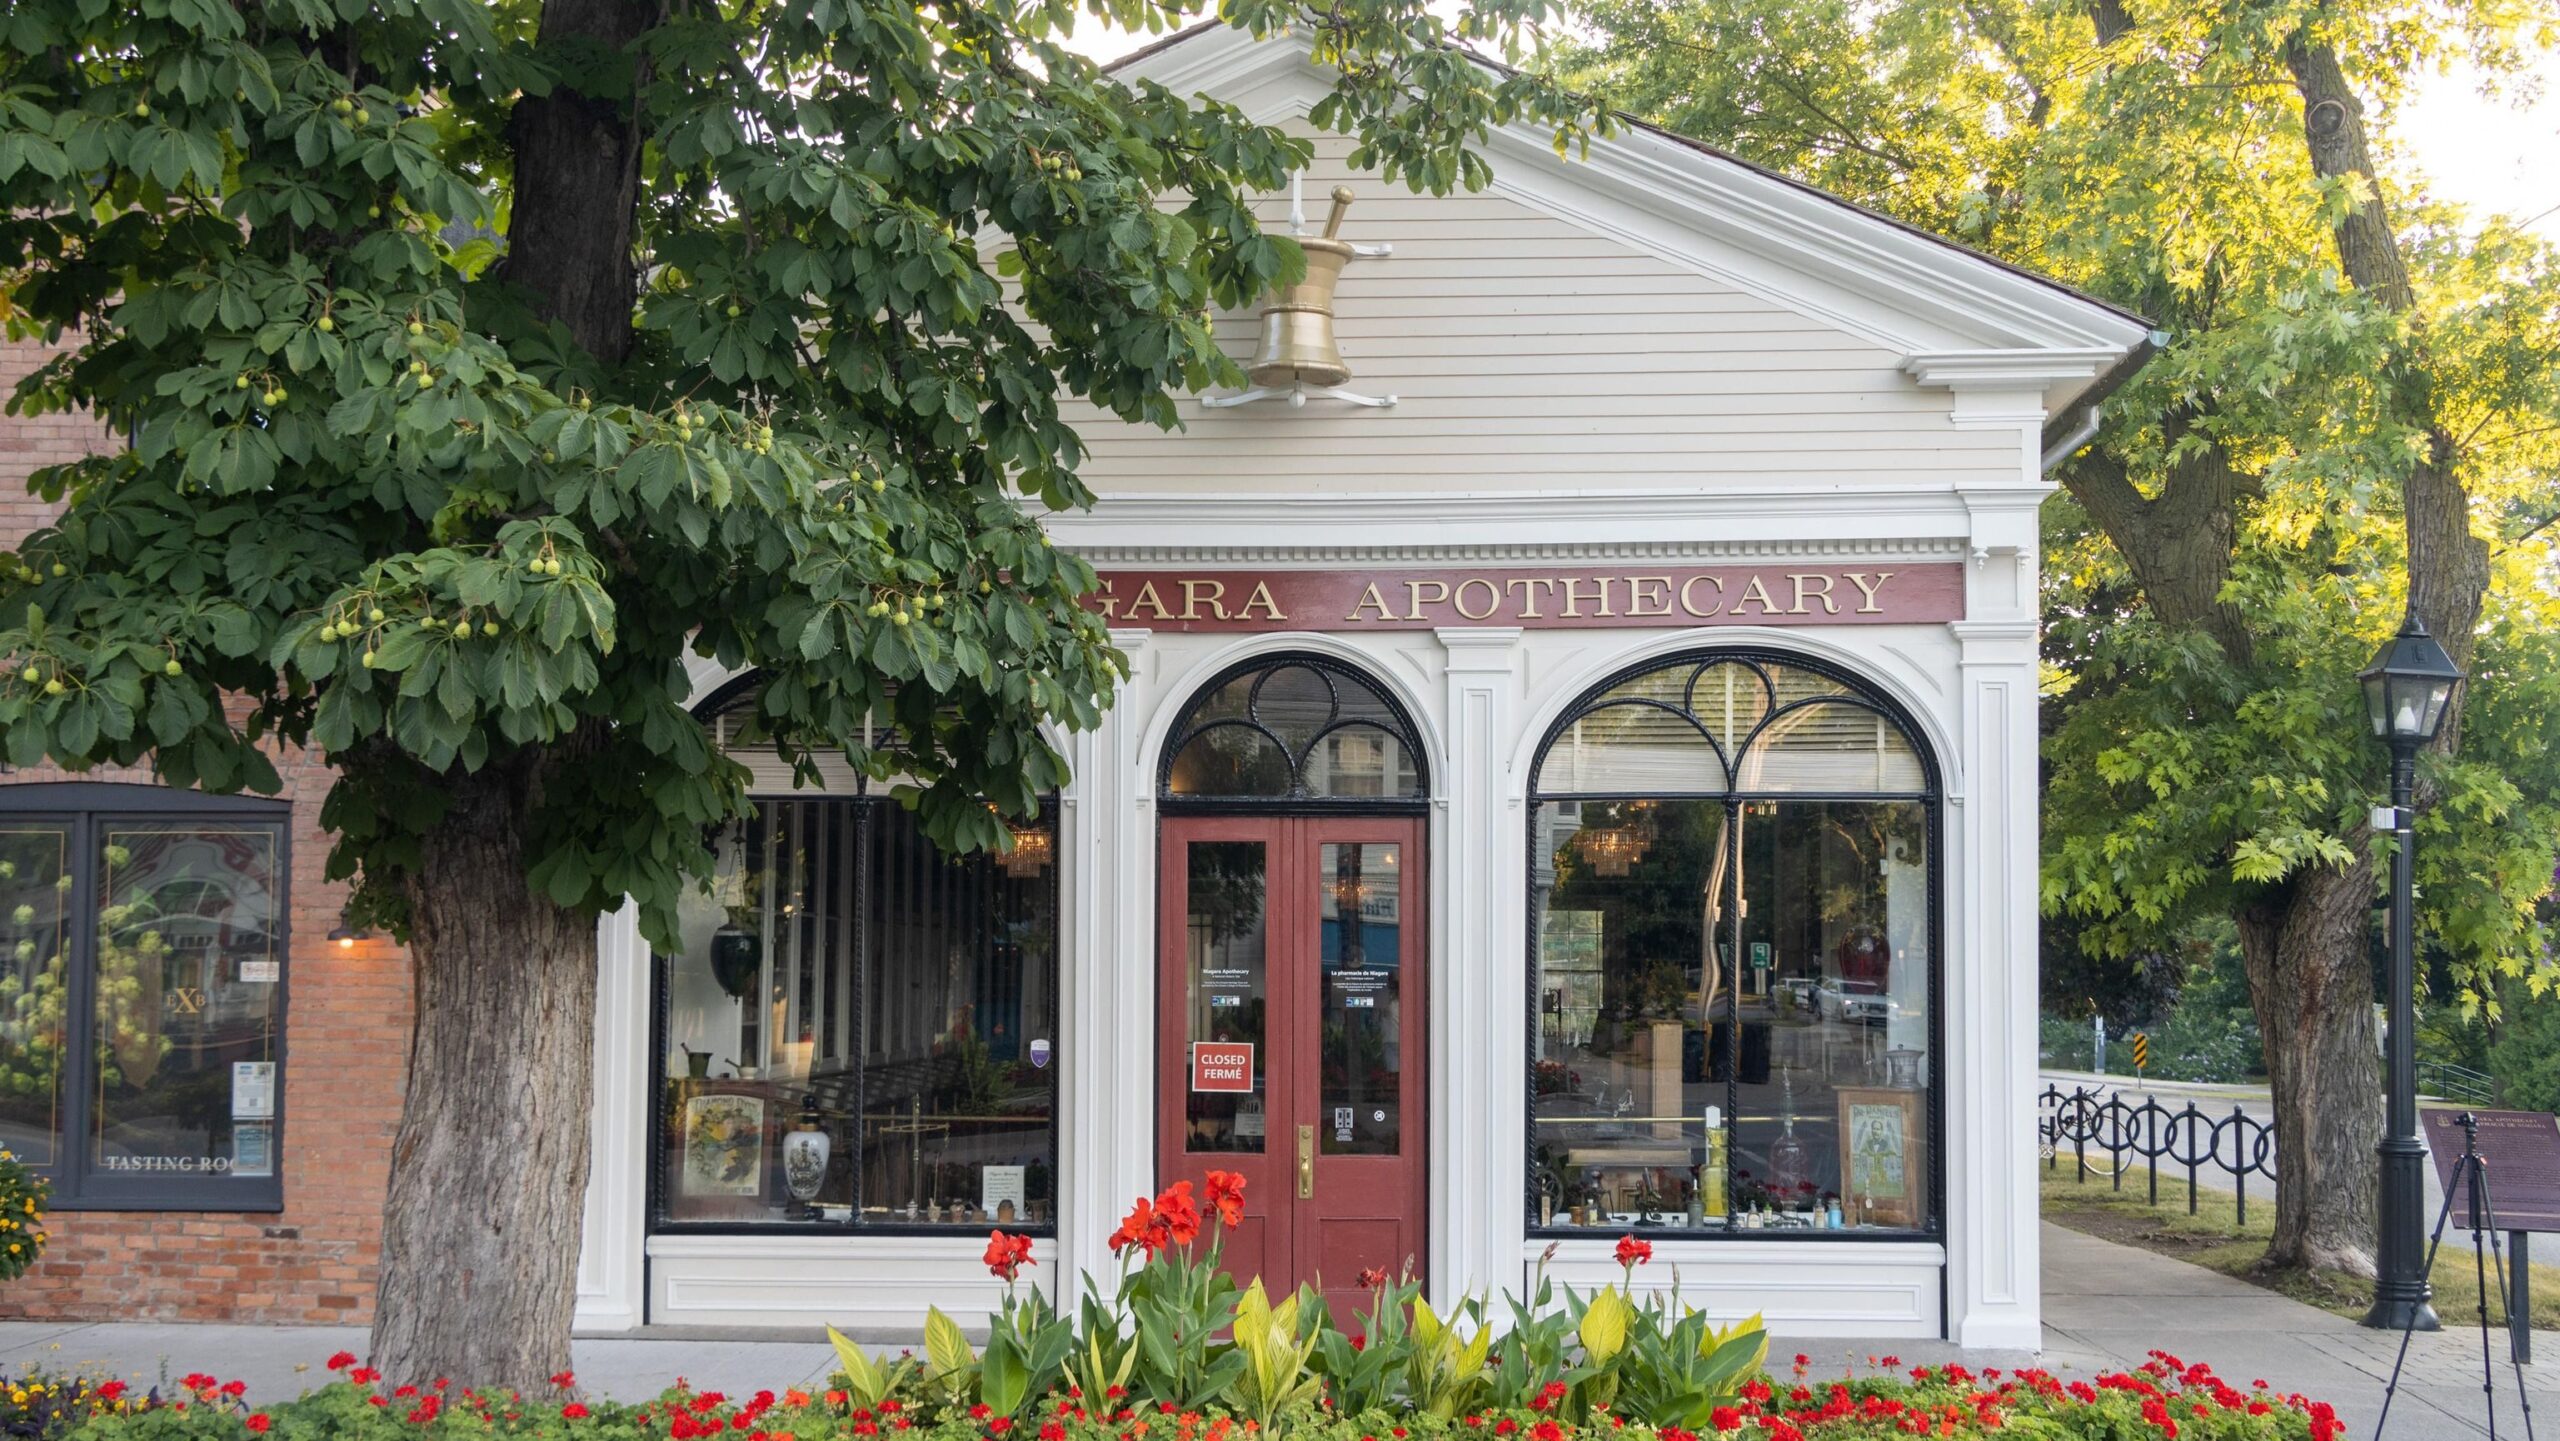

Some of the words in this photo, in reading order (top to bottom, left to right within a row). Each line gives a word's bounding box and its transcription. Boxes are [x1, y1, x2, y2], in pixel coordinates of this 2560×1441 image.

[1076, 579, 1288, 621] GARA
[1346, 572, 1894, 621] APOTHECARY
[1201, 1054, 1246, 1066] CLOSED
[1204, 1067, 1243, 1080] FERMÉ
[107, 1155, 193, 1172] TASTING
